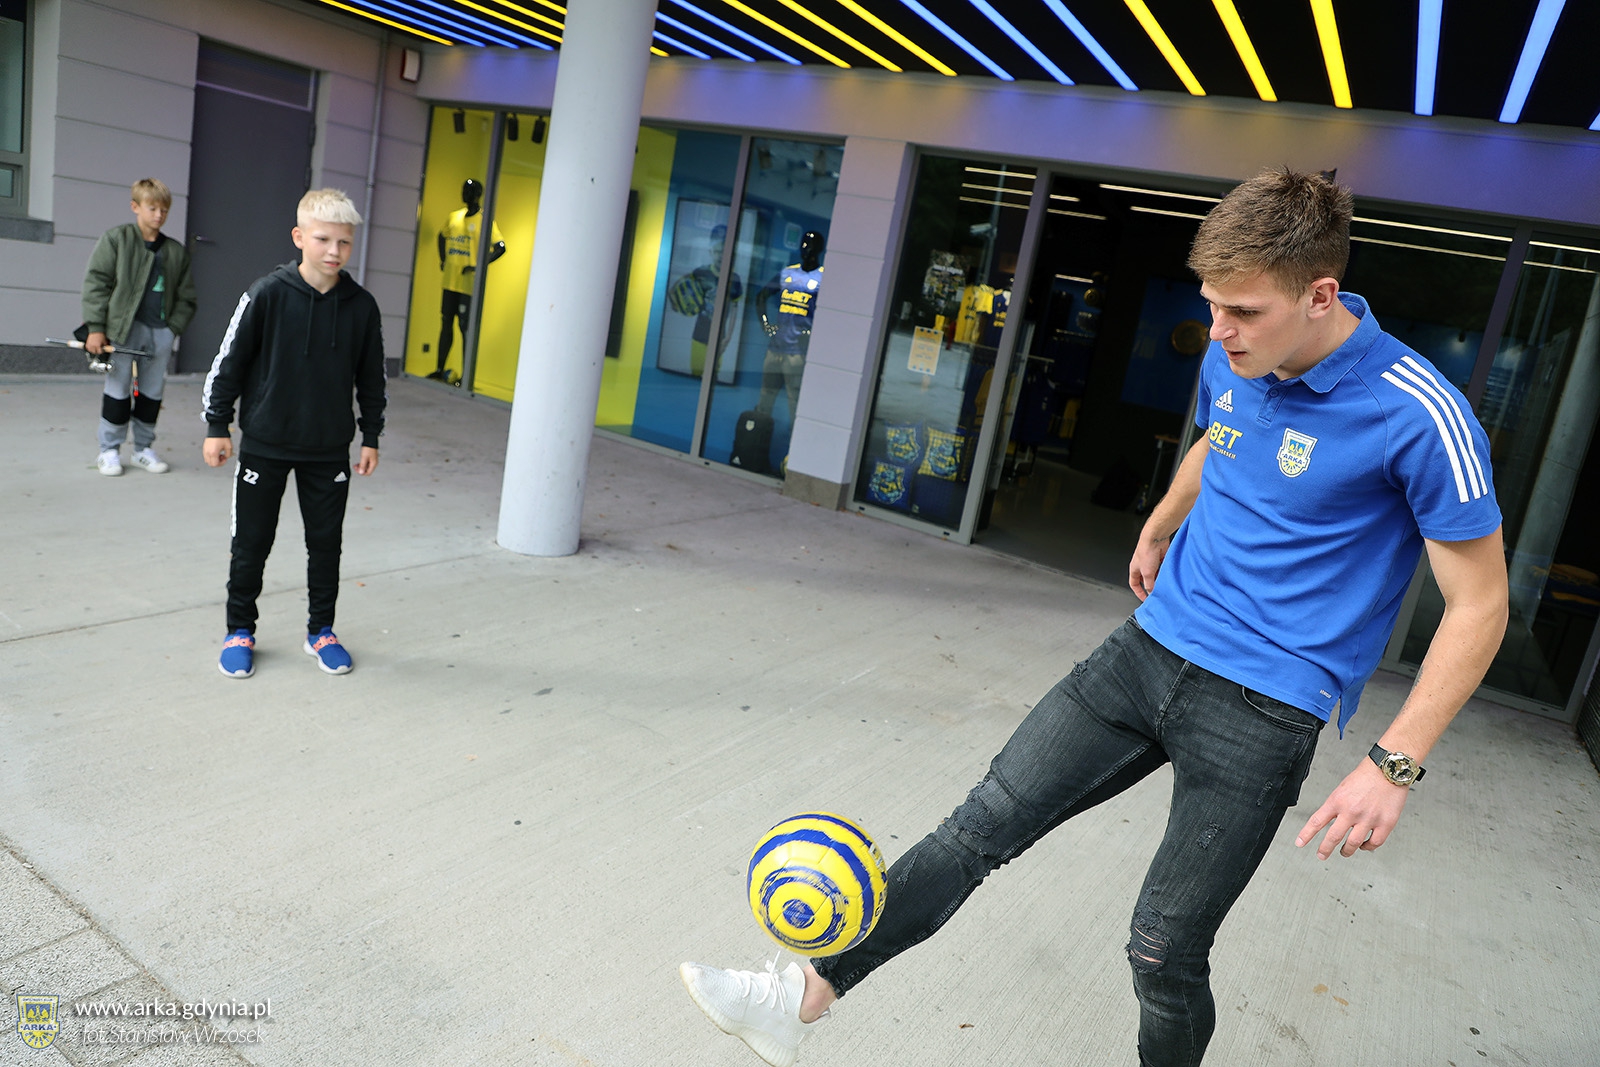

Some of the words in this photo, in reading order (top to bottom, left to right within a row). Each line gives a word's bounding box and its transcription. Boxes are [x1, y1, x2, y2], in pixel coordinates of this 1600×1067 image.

[1214, 399, 1234, 414] adidas
[1209, 421, 1243, 449] BET
[1283, 453, 1303, 464] ARKA
[242, 468, 260, 485] 22
